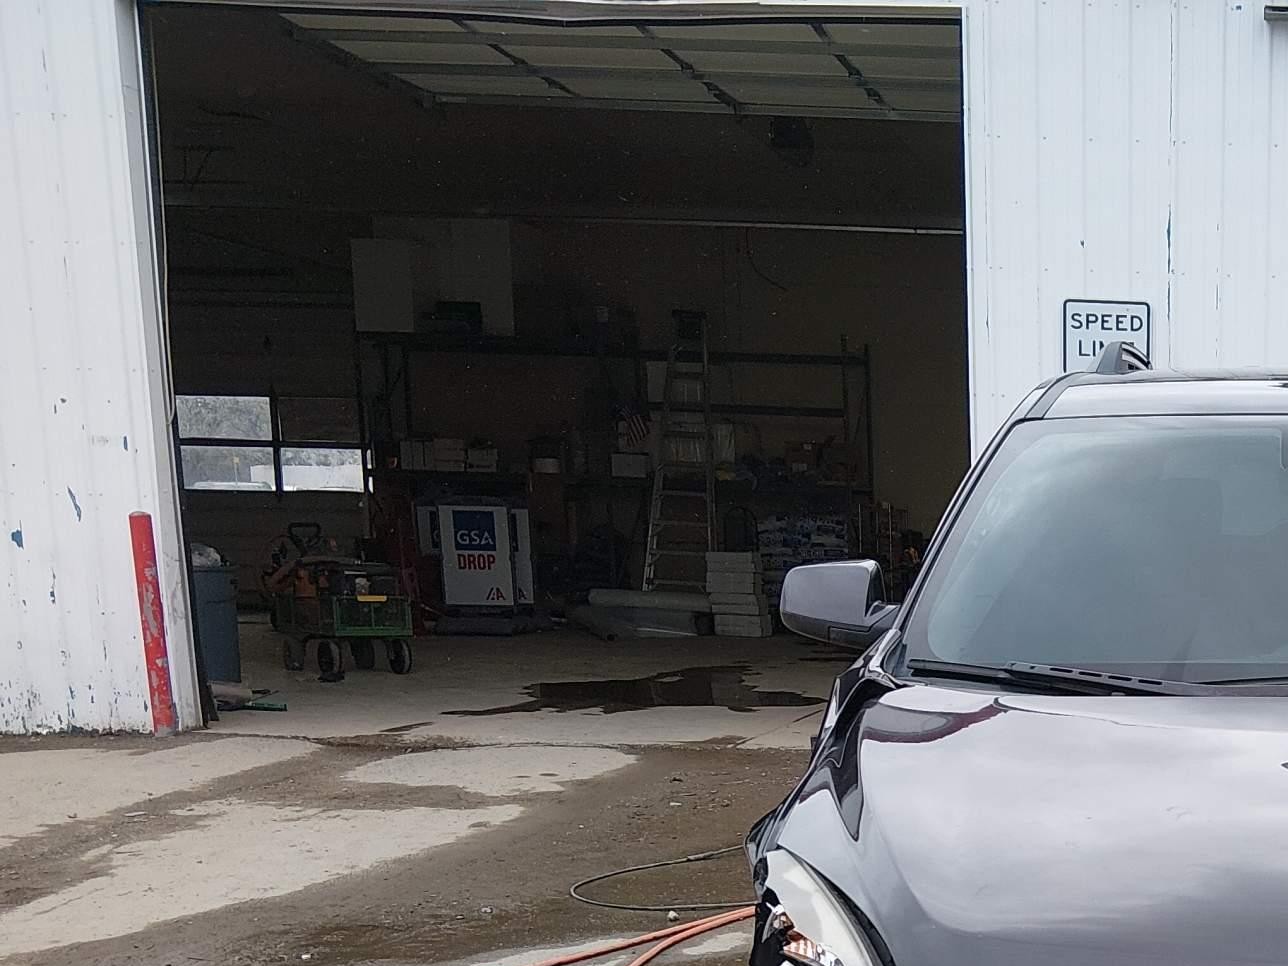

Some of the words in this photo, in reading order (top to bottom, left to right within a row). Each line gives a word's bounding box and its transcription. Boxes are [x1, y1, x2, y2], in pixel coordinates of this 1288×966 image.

[1070, 312, 1144, 332] SPEED
[456, 530, 494, 545] GSA
[457, 553, 496, 571] DROP
